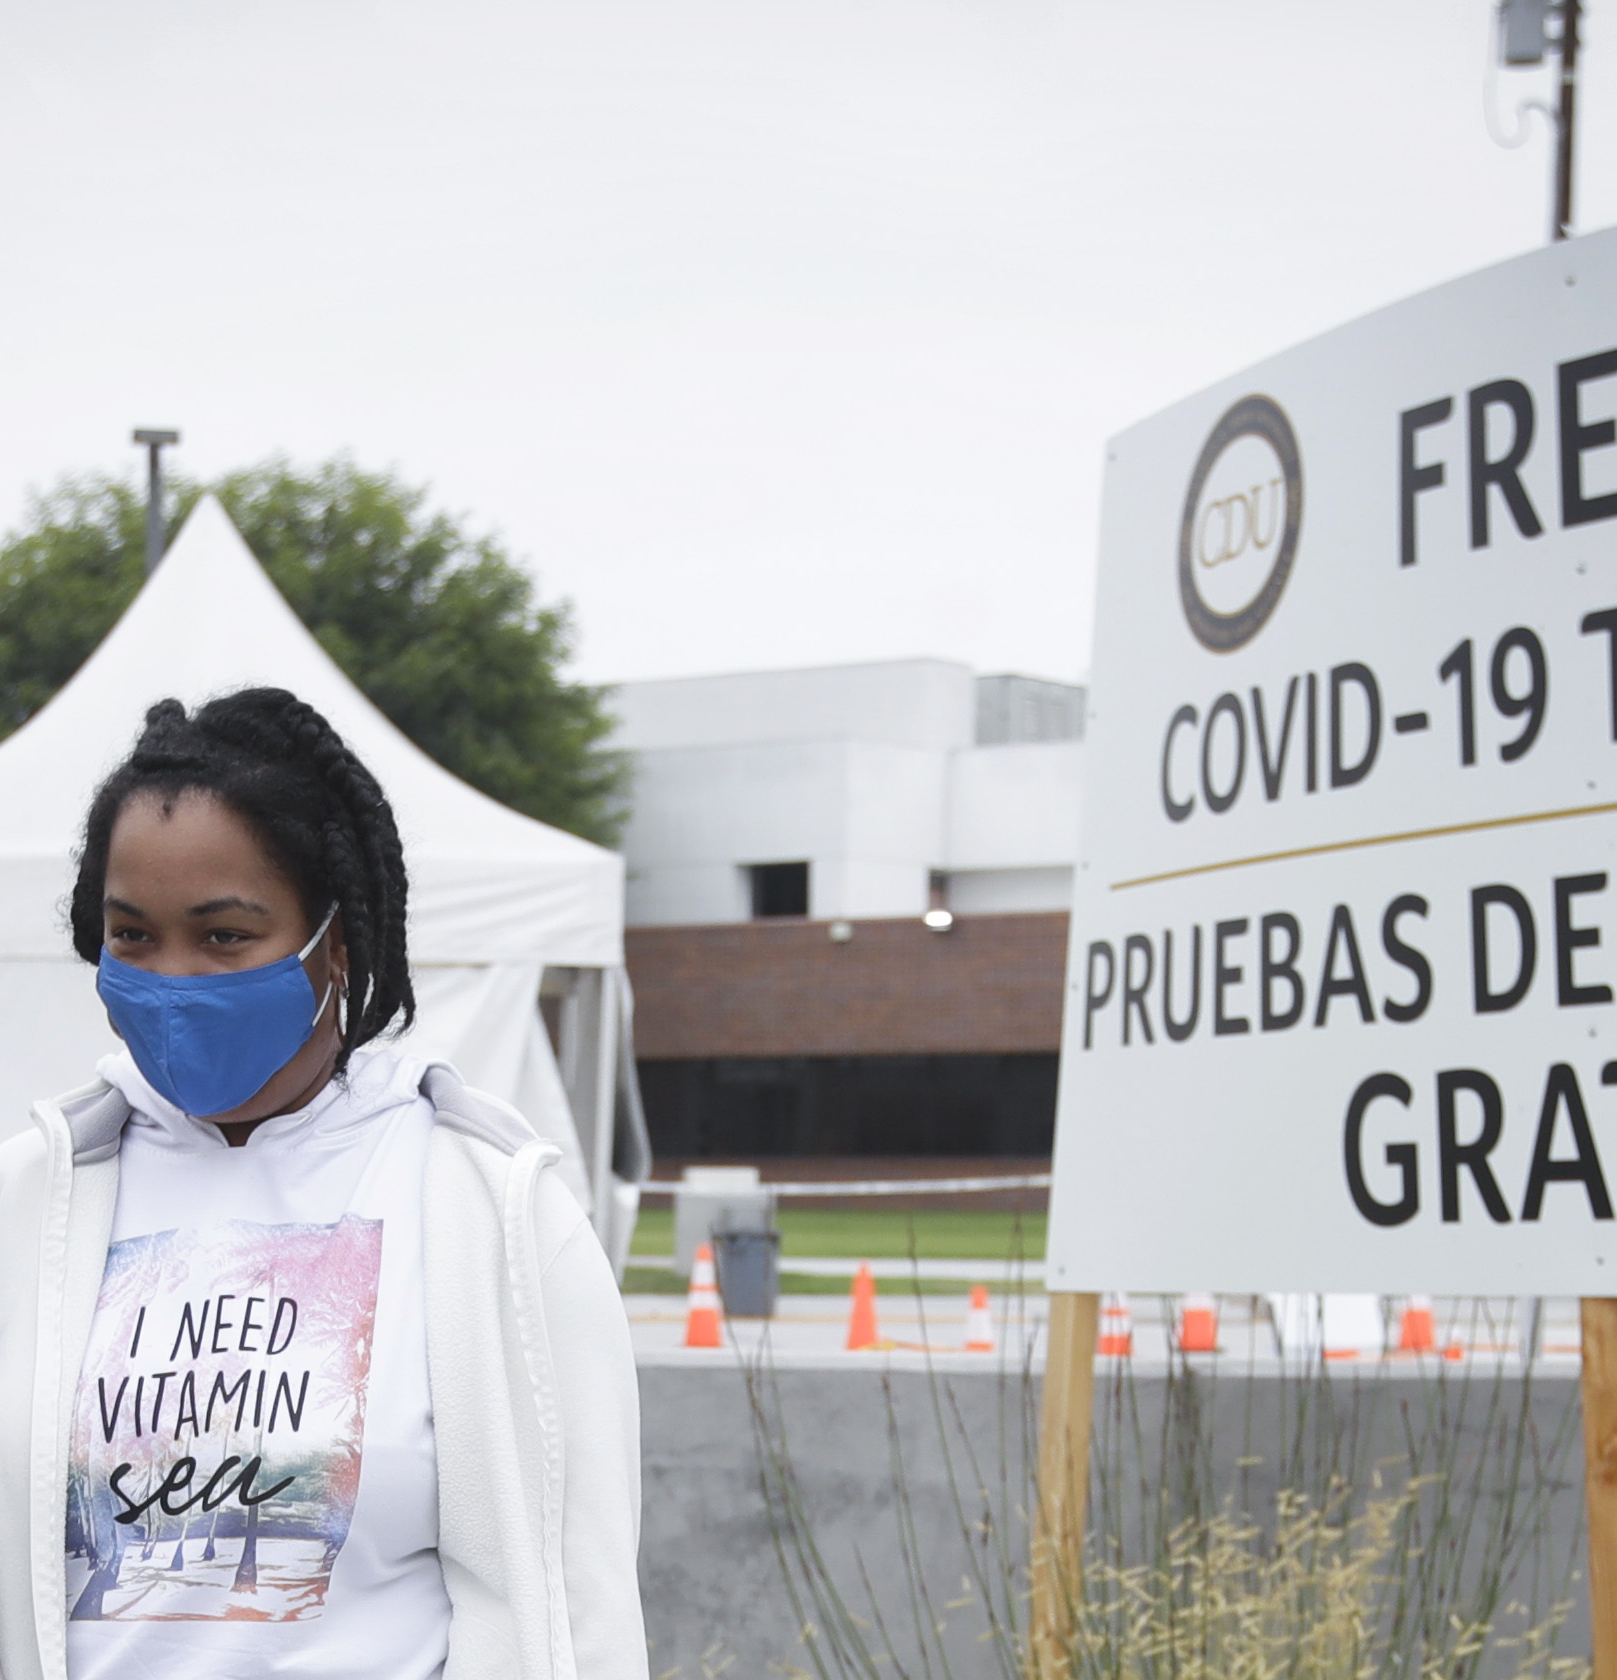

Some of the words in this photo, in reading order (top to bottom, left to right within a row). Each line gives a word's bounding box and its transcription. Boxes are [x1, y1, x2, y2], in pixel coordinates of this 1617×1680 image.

[1160, 625, 1550, 823] COVID-19
[1082, 892, 1432, 1051] PRUEBAS
[1470, 871, 1613, 1015] DE
[130, 1306, 146, 1358] I
[170, 1295, 298, 1362] NEED
[98, 1369, 311, 1444] VITAMIN
[109, 1455, 296, 1525] sea
